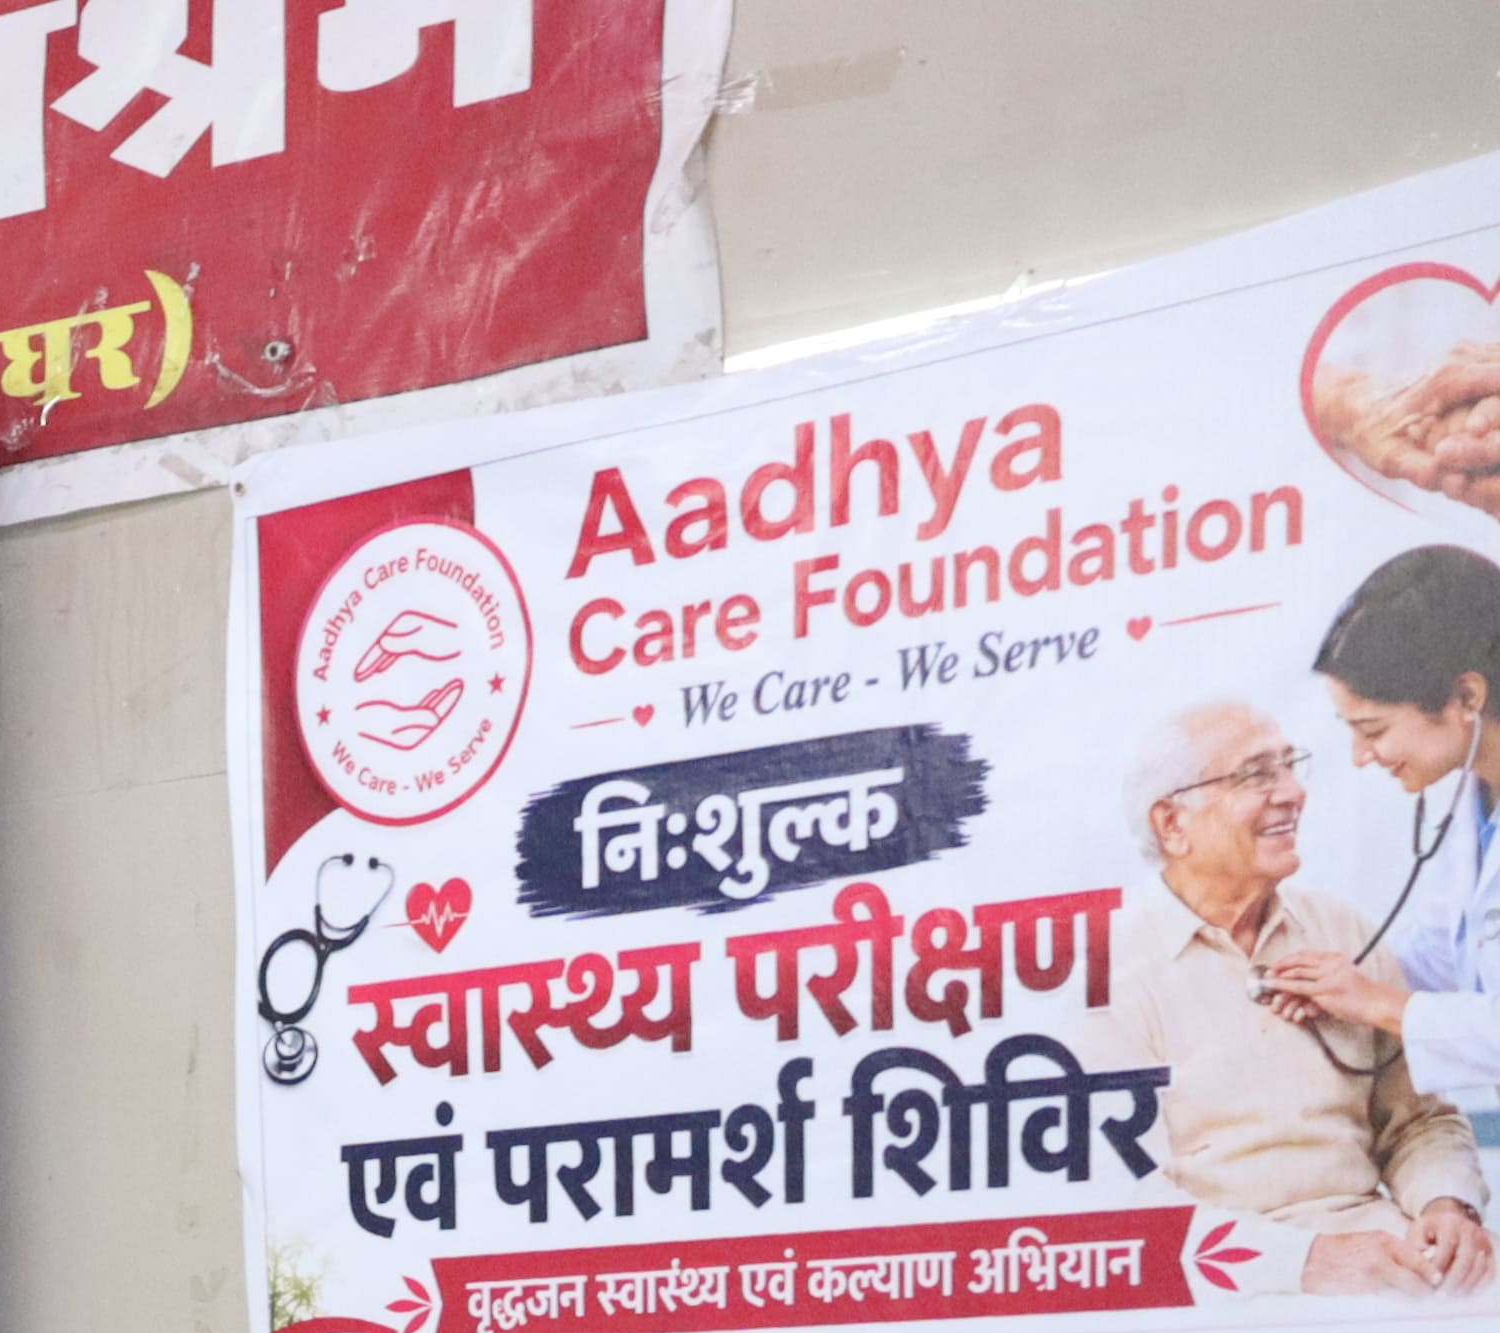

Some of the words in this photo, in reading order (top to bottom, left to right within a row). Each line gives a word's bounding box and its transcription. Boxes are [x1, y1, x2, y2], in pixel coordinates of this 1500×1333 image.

[564, 403, 1063, 580] Aadhya
[314, 590, 362, 682] Aadhya
[363, 555, 409, 589] Care
[415, 548, 505, 651] Foundation
[569, 592, 762, 675] Care
[792, 484, 1304, 640] Foundation
[681, 680, 738, 729] We
[753, 669, 852, 718] Care
[897, 642, 959, 691] We
[972, 620, 1101, 679] Serve
[332, 740, 354, 775] We
[358, 767, 397, 796] Care
[414, 770, 445, 792] We
[449, 718, 492, 775] Serve
[347, 940, 702, 1088] स्वास्थ्य
[725, 881, 1123, 1044] परीक्षण
[341, 1099, 463, 1240] एवं
[485, 1056, 817, 1226] परामर्श
[843, 1032, 1171, 1199] शिविर
[738, 1248, 798, 1305] एवं
[806, 1250, 955, 1305] कल्याण
